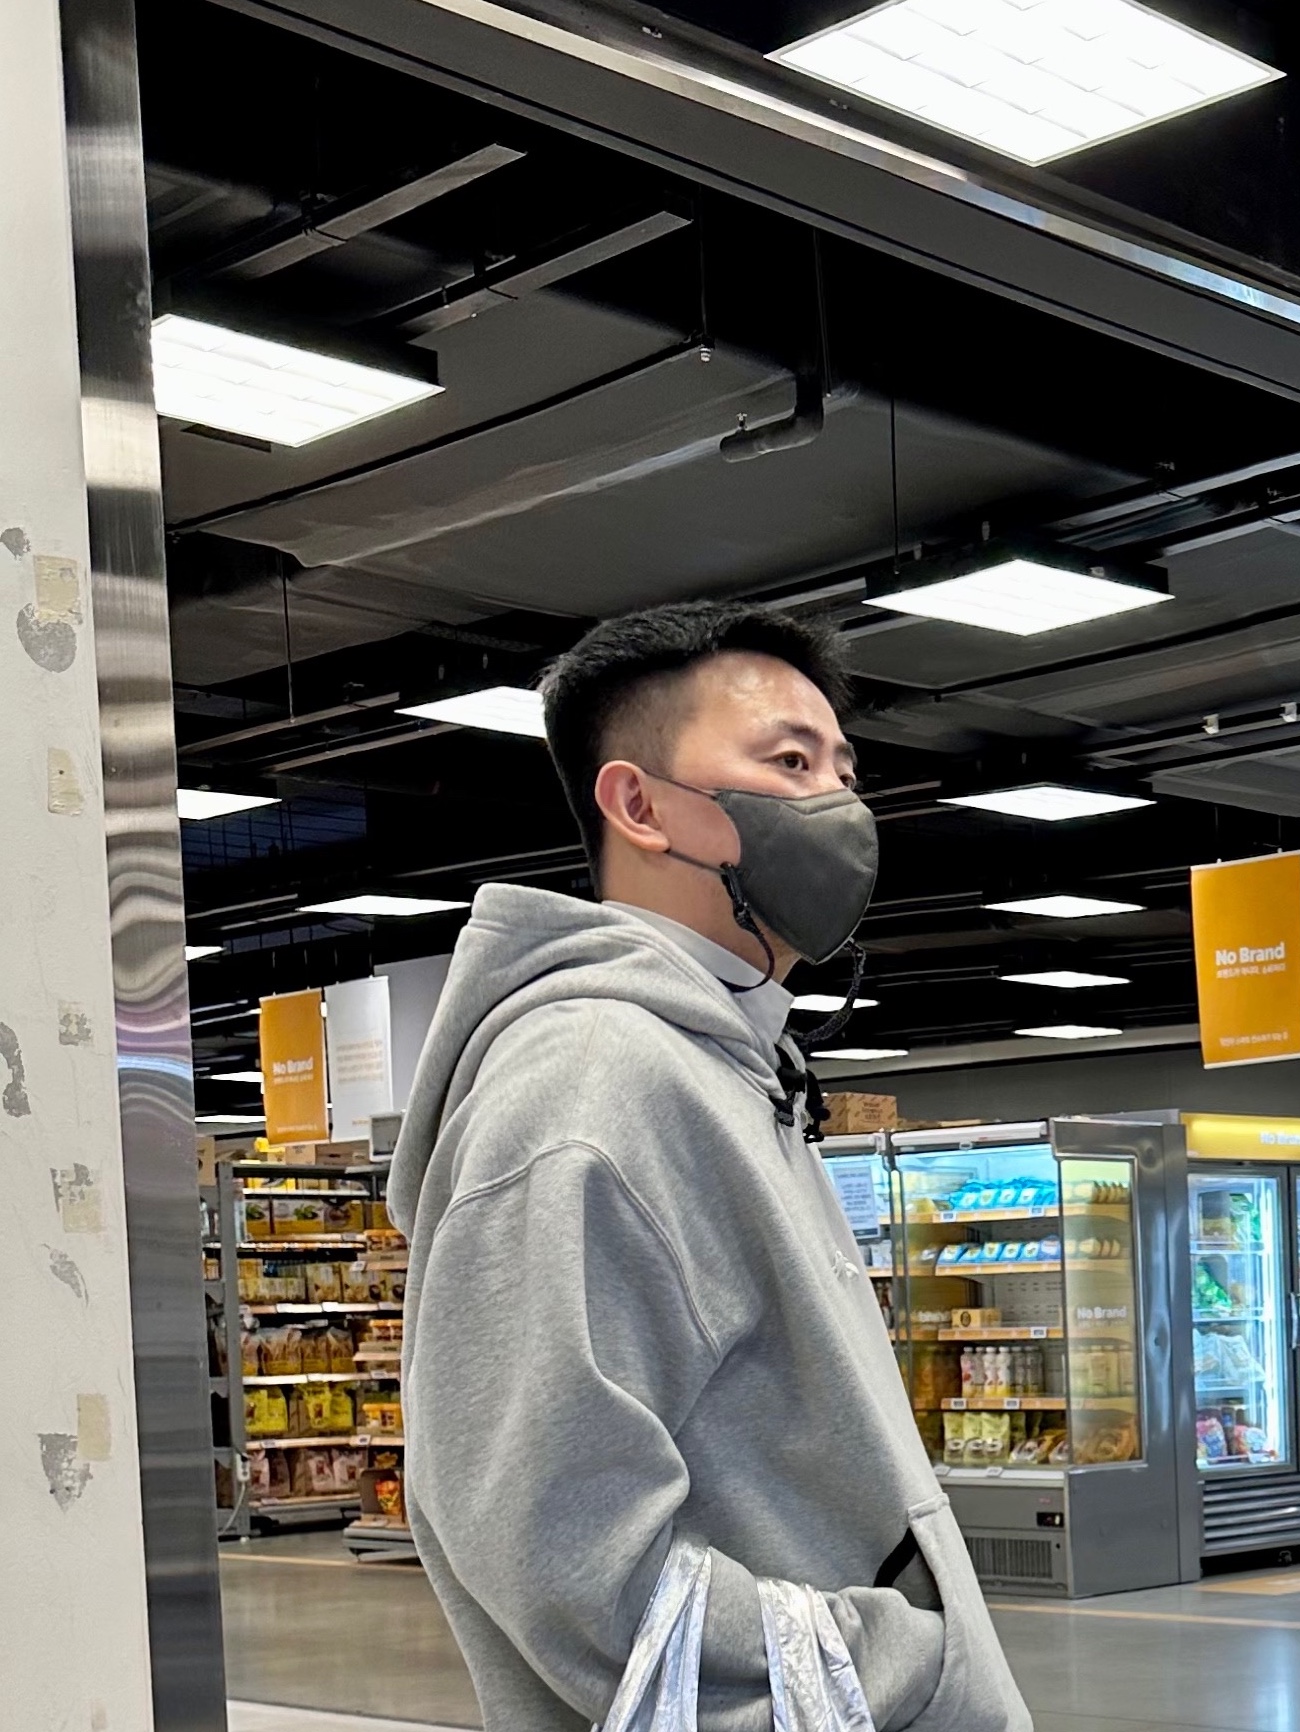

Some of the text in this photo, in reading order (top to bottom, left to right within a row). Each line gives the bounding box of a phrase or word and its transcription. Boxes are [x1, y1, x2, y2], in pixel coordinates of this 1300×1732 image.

[1215, 941, 1285, 966] No Brand
[1094, 1306, 1127, 1319] Brand
